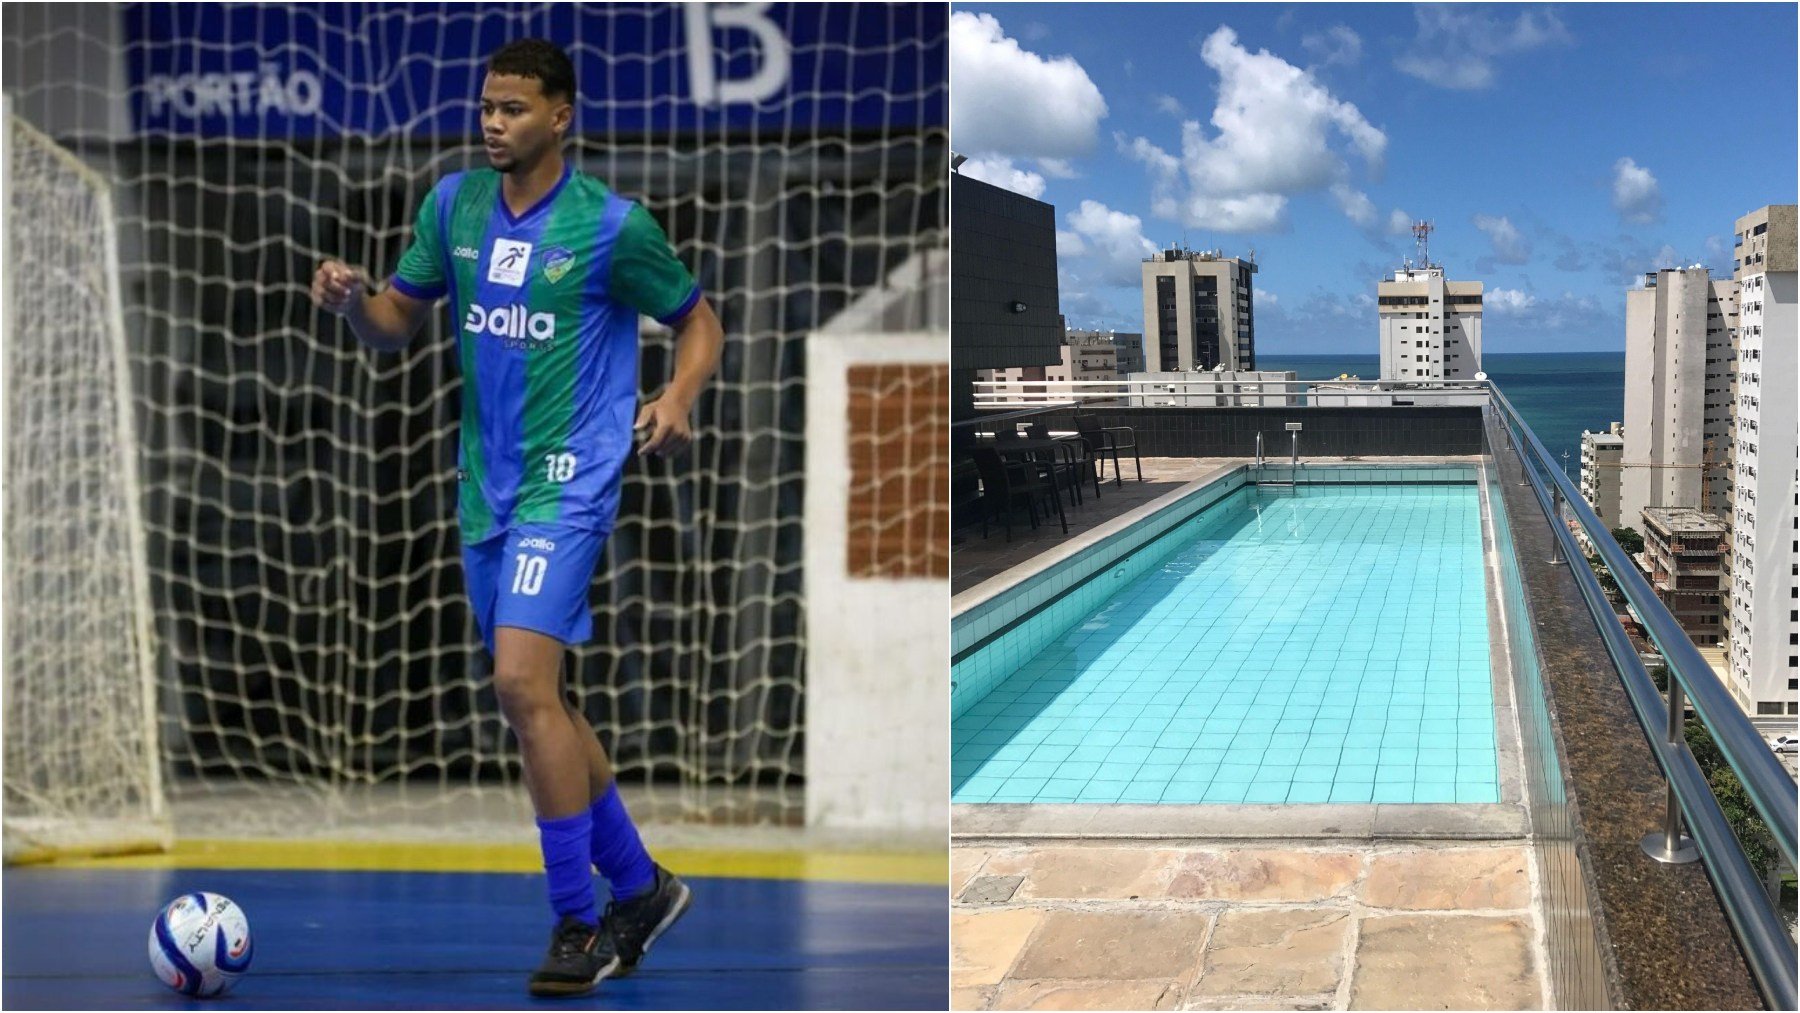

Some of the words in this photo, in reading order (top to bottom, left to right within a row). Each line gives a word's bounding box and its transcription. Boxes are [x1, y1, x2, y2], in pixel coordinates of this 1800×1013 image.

[147, 61, 322, 116] PORTÃO
[545, 452, 577, 482] 10
[512, 553, 548, 596] 10
[188, 899, 231, 954] PENALTY
